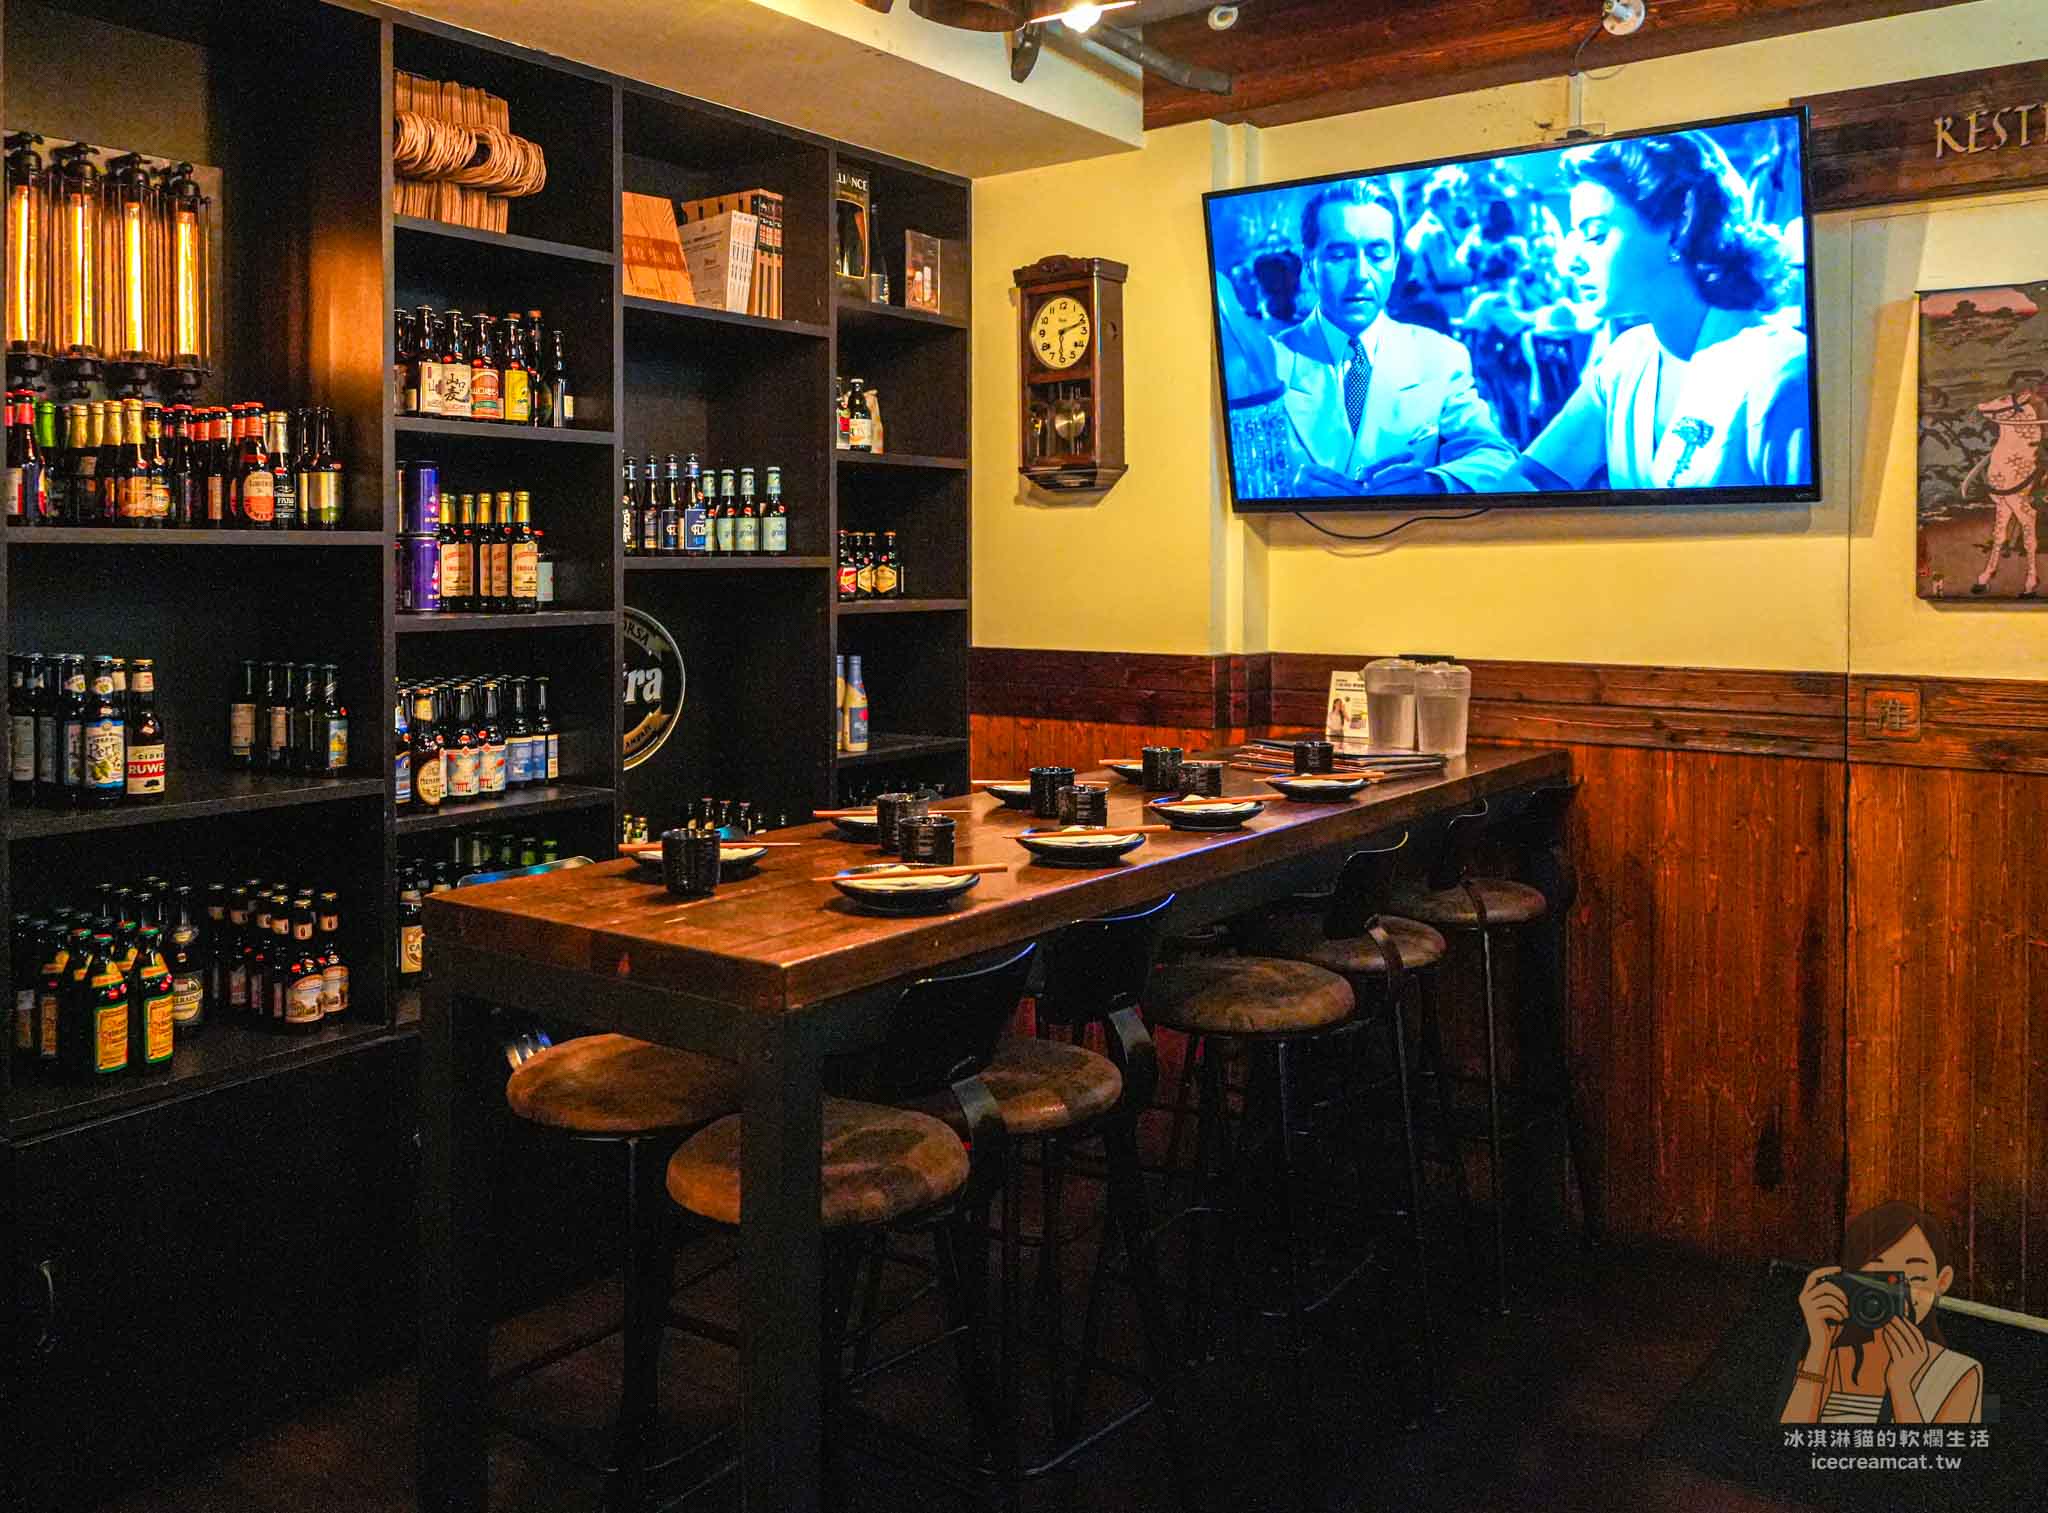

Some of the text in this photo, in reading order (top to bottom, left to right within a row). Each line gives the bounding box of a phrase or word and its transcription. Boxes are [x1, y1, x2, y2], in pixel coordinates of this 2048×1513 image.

[1049, 305, 1055, 315] 11
[1059, 301, 1068, 310] 12
[1041, 316, 1049, 325] 10
